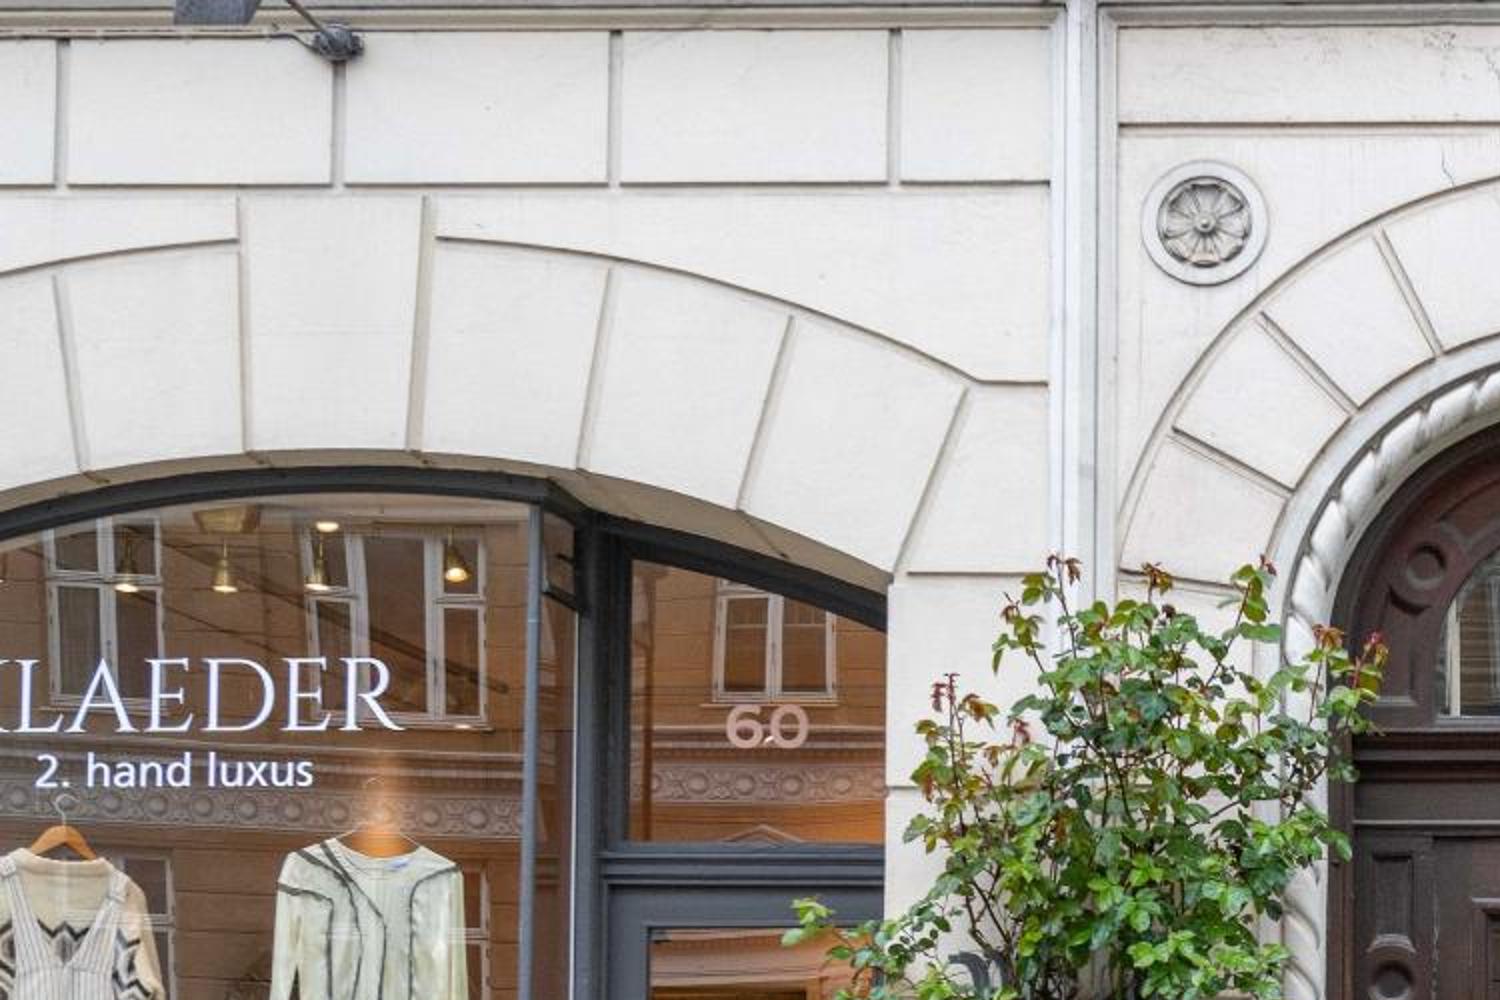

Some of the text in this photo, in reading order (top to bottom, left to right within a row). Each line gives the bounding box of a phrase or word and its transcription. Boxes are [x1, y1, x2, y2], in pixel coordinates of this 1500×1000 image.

[0, 657, 405, 733] LAEDER
[726, 703, 809, 749] 60
[34, 751, 315, 788] 2. hand luxus
